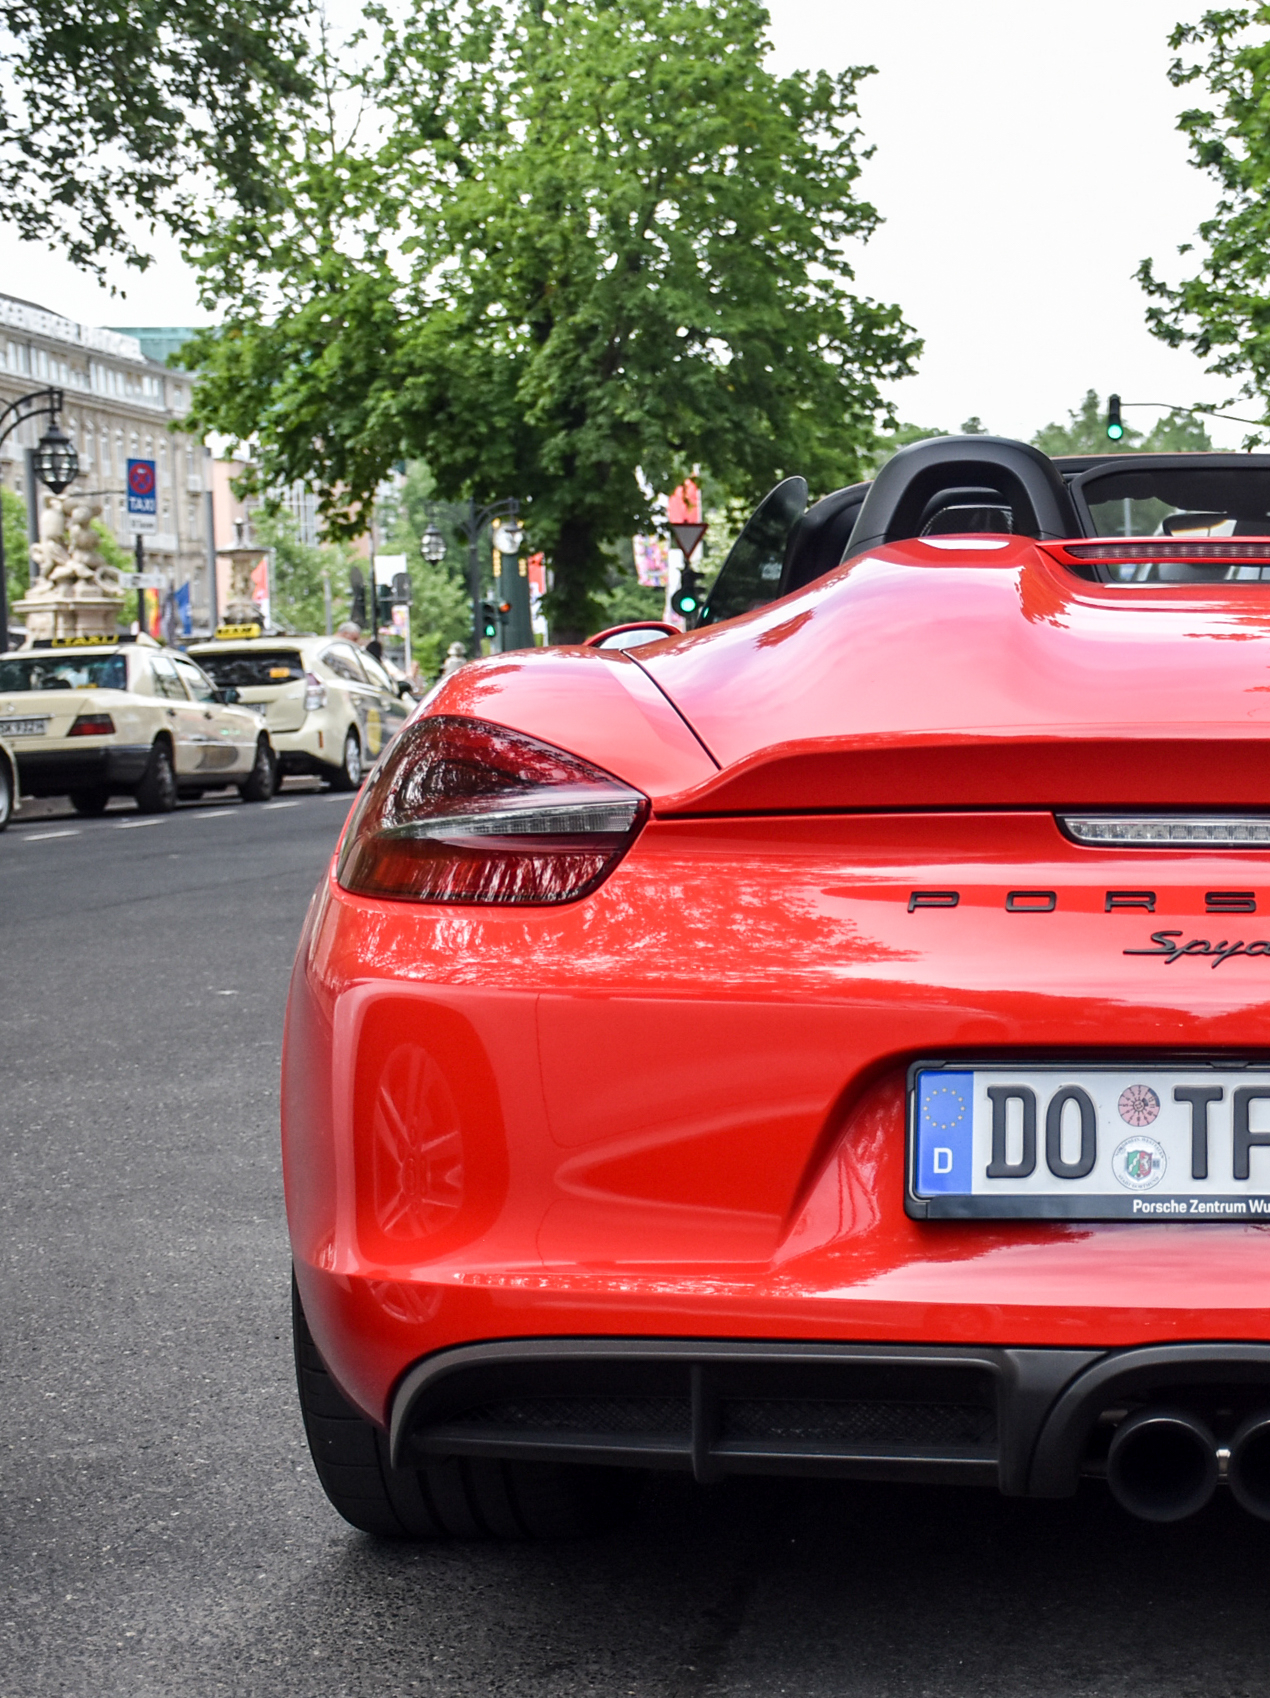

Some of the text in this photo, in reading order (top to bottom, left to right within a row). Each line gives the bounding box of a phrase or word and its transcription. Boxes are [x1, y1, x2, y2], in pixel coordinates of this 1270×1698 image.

[129, 496, 156, 511] TAXI
[985, 1085, 1097, 1181] DO
[932, 1147, 953, 1174] D
[1132, 1199, 1187, 1214] Porsche
[1189, 1199, 1247, 1214] Zentrum
